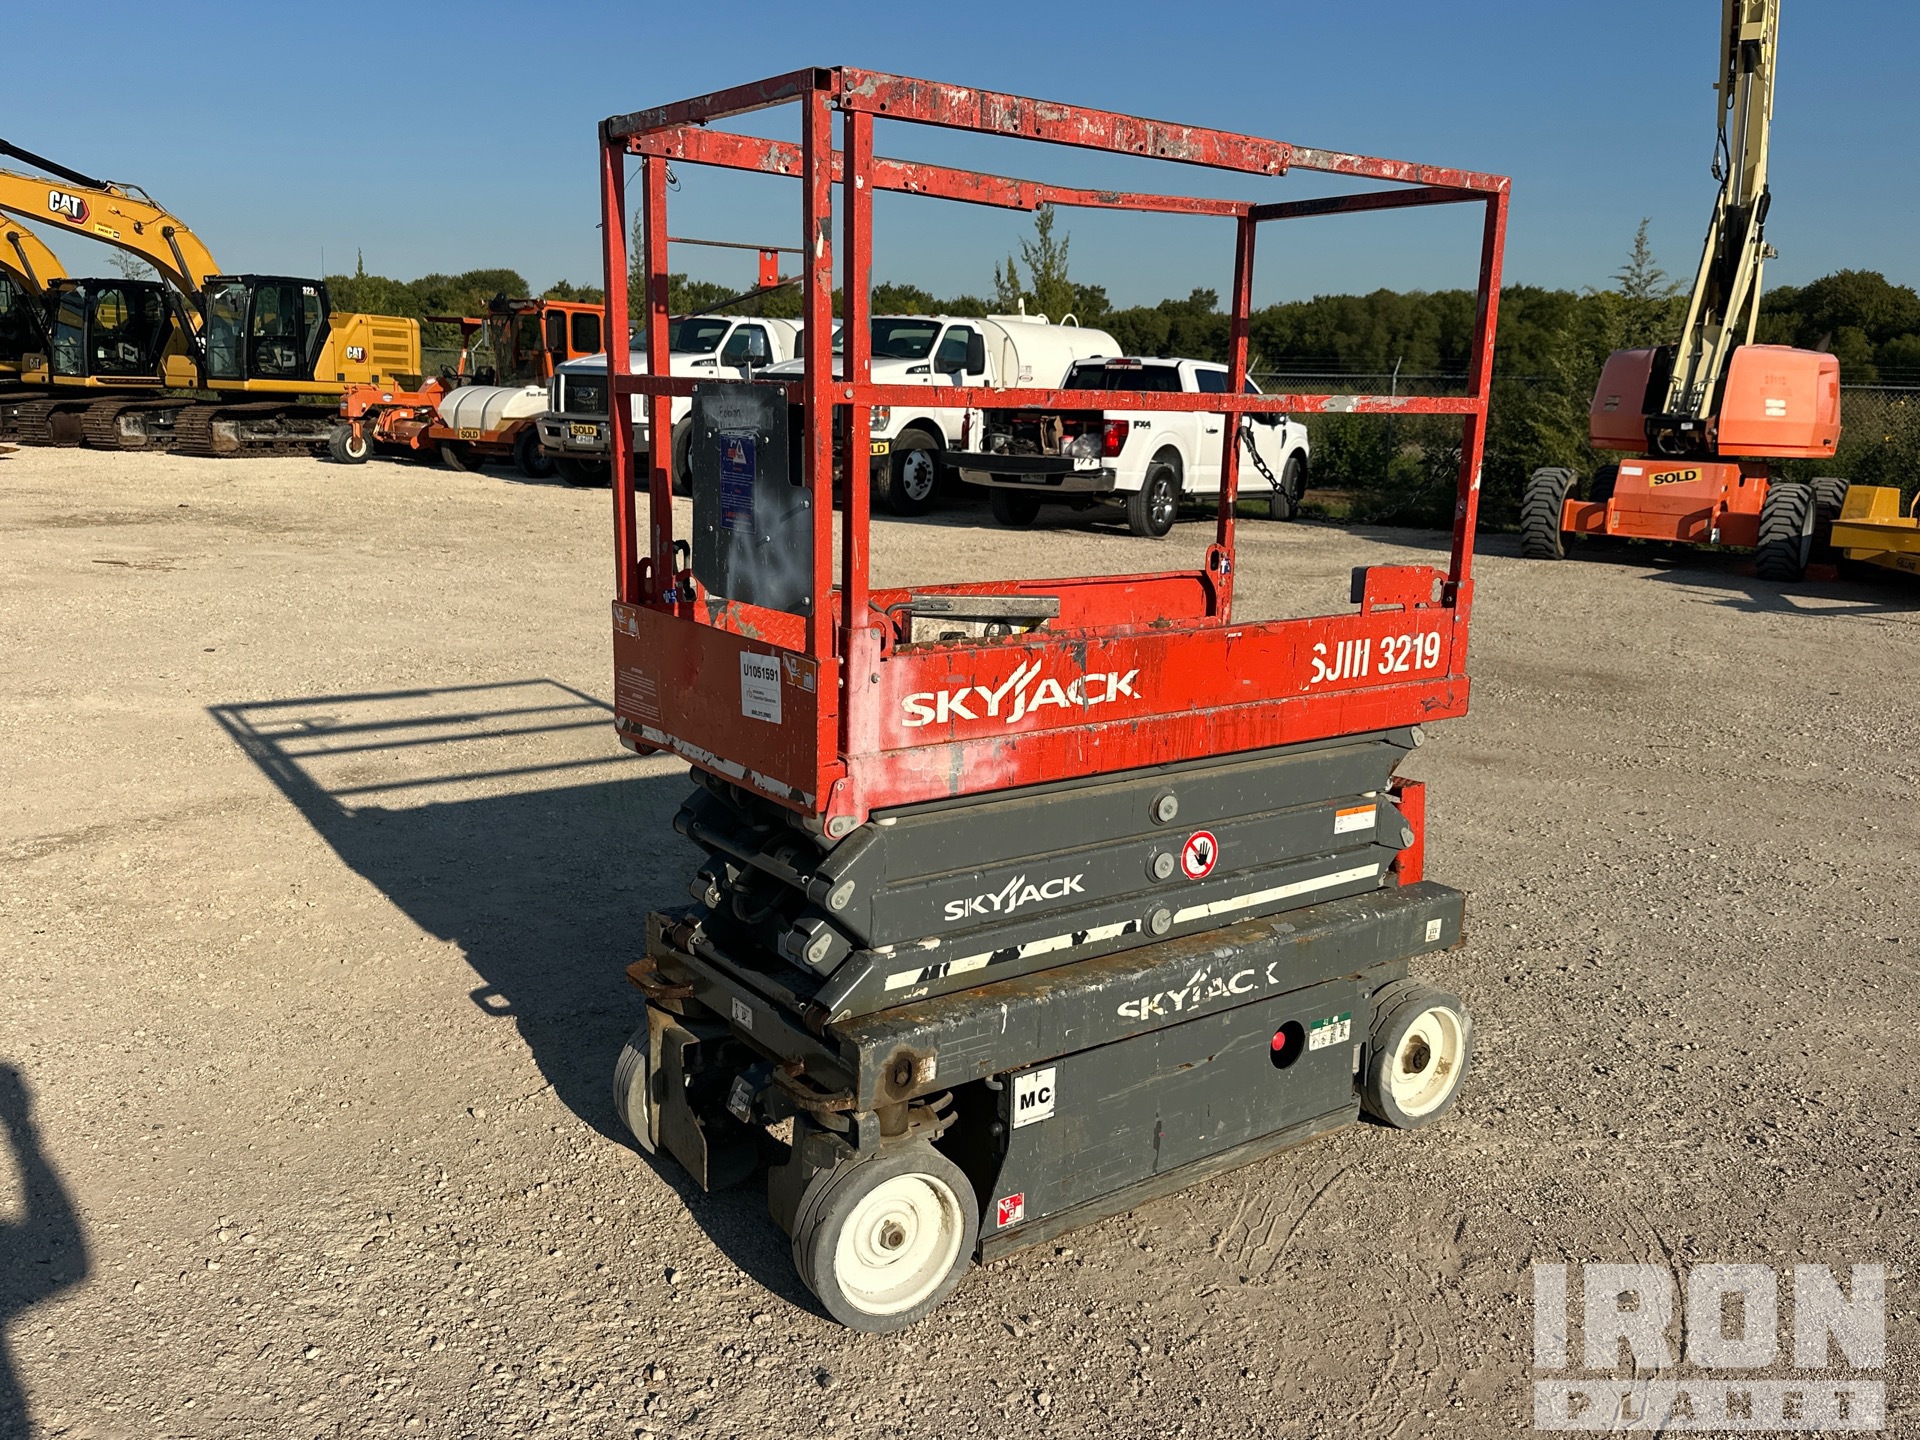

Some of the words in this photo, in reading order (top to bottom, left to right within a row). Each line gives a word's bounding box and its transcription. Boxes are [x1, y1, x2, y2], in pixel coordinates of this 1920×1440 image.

[49, 190, 80, 217] CAT
[302, 286, 314, 295] 323
[347, 346, 363, 360] CAT
[573, 425, 594, 435] SOLD
[1133, 420, 1151, 430] FX4
[461, 430, 478, 439] SOLD
[871, 444, 886, 454] LD
[1653, 470, 1697, 485] SOLD
[1378, 631, 1441, 674] 3219
[743, 663, 778, 682] U1051591
[901, 658, 1142, 727] SKYJACK
[944, 873, 1086, 921] SKYJACK
[1020, 1086, 1051, 1111] MC
